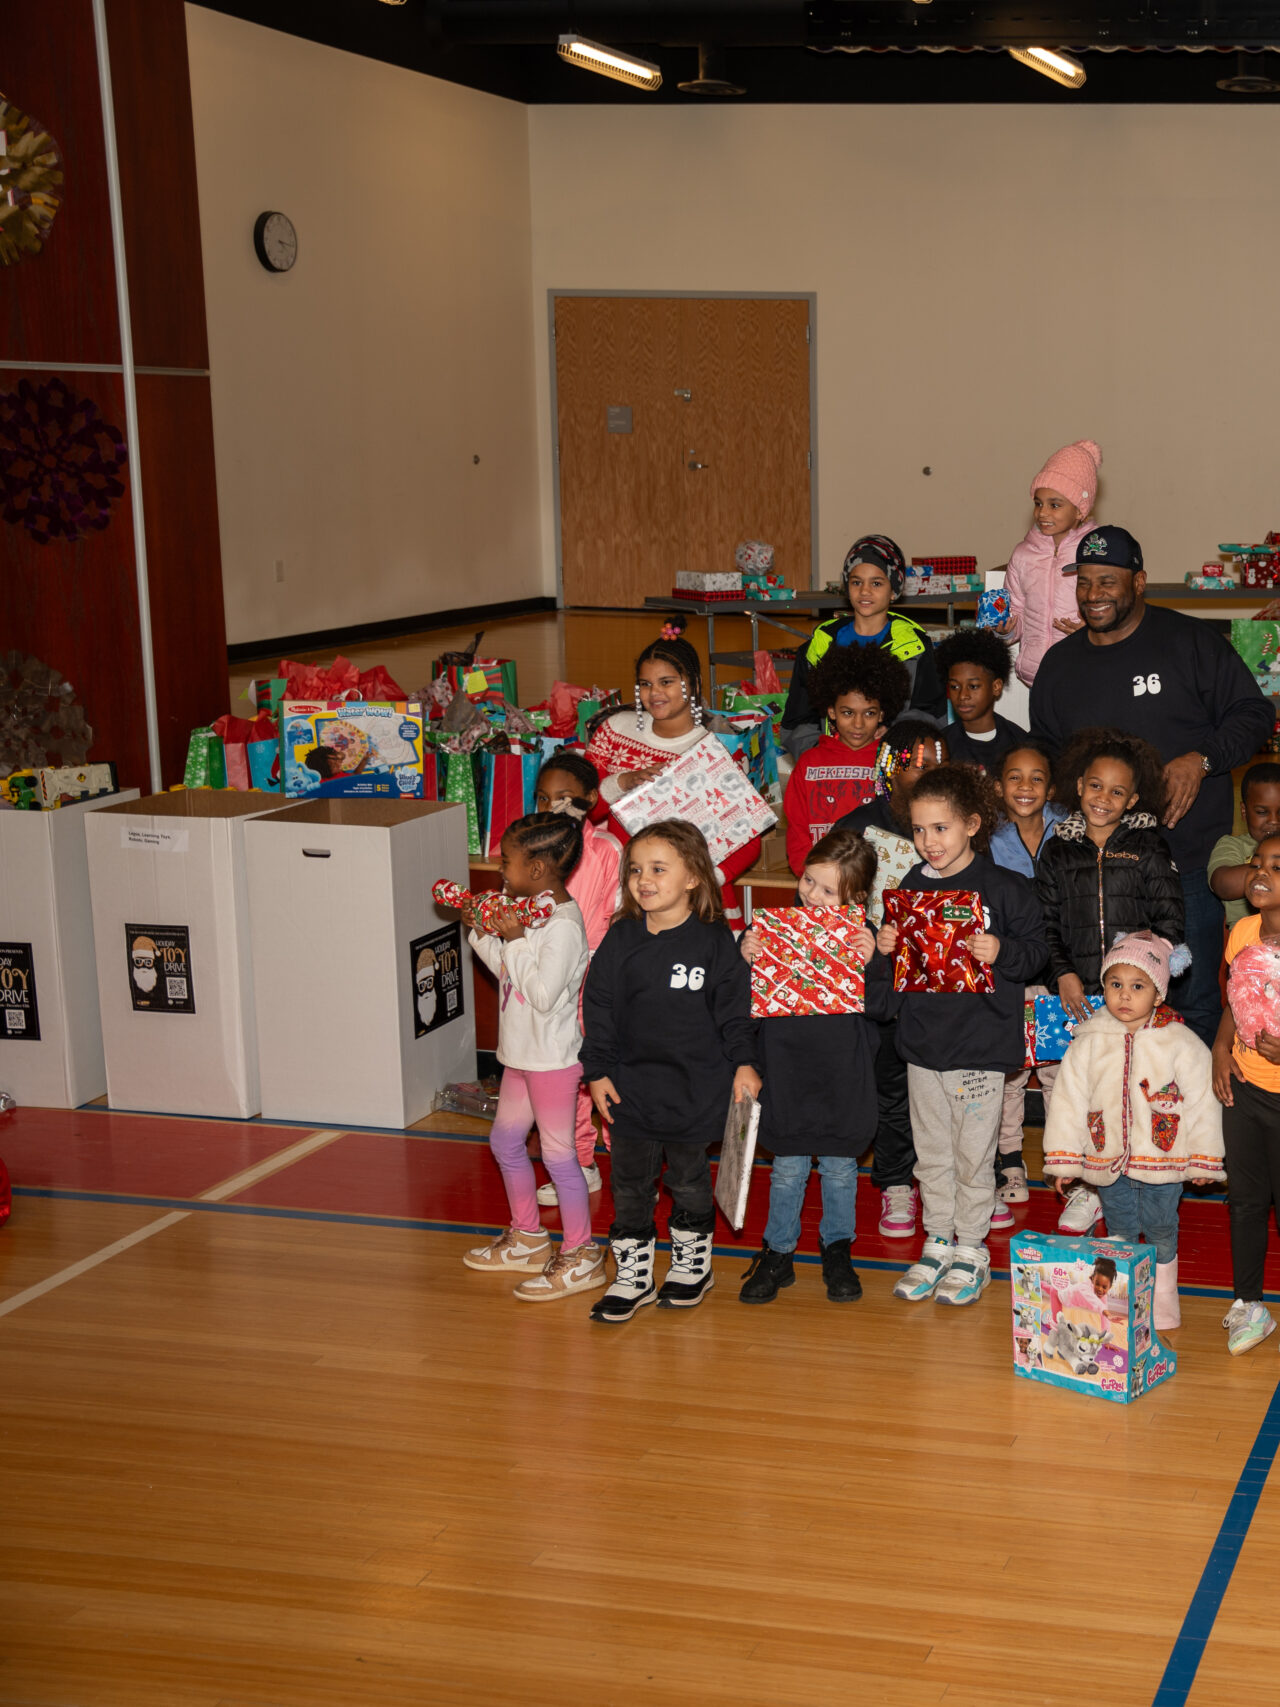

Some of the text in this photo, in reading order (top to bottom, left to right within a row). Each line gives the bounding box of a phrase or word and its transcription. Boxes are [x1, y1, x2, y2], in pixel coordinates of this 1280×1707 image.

[1133, 673, 1161, 697] 36
[806, 767, 877, 780] MCKEESPO
[1105, 851, 1140, 861] bebe
[160, 947, 187, 963] TOY
[438, 947, 460, 974] TOY
[164, 962, 187, 973] DRIVE
[0, 966, 29, 990] OY
[441, 968, 459, 988] DRIVE
[670, 963, 705, 991] 36
[1053, 1266, 1067, 1276] 60+
